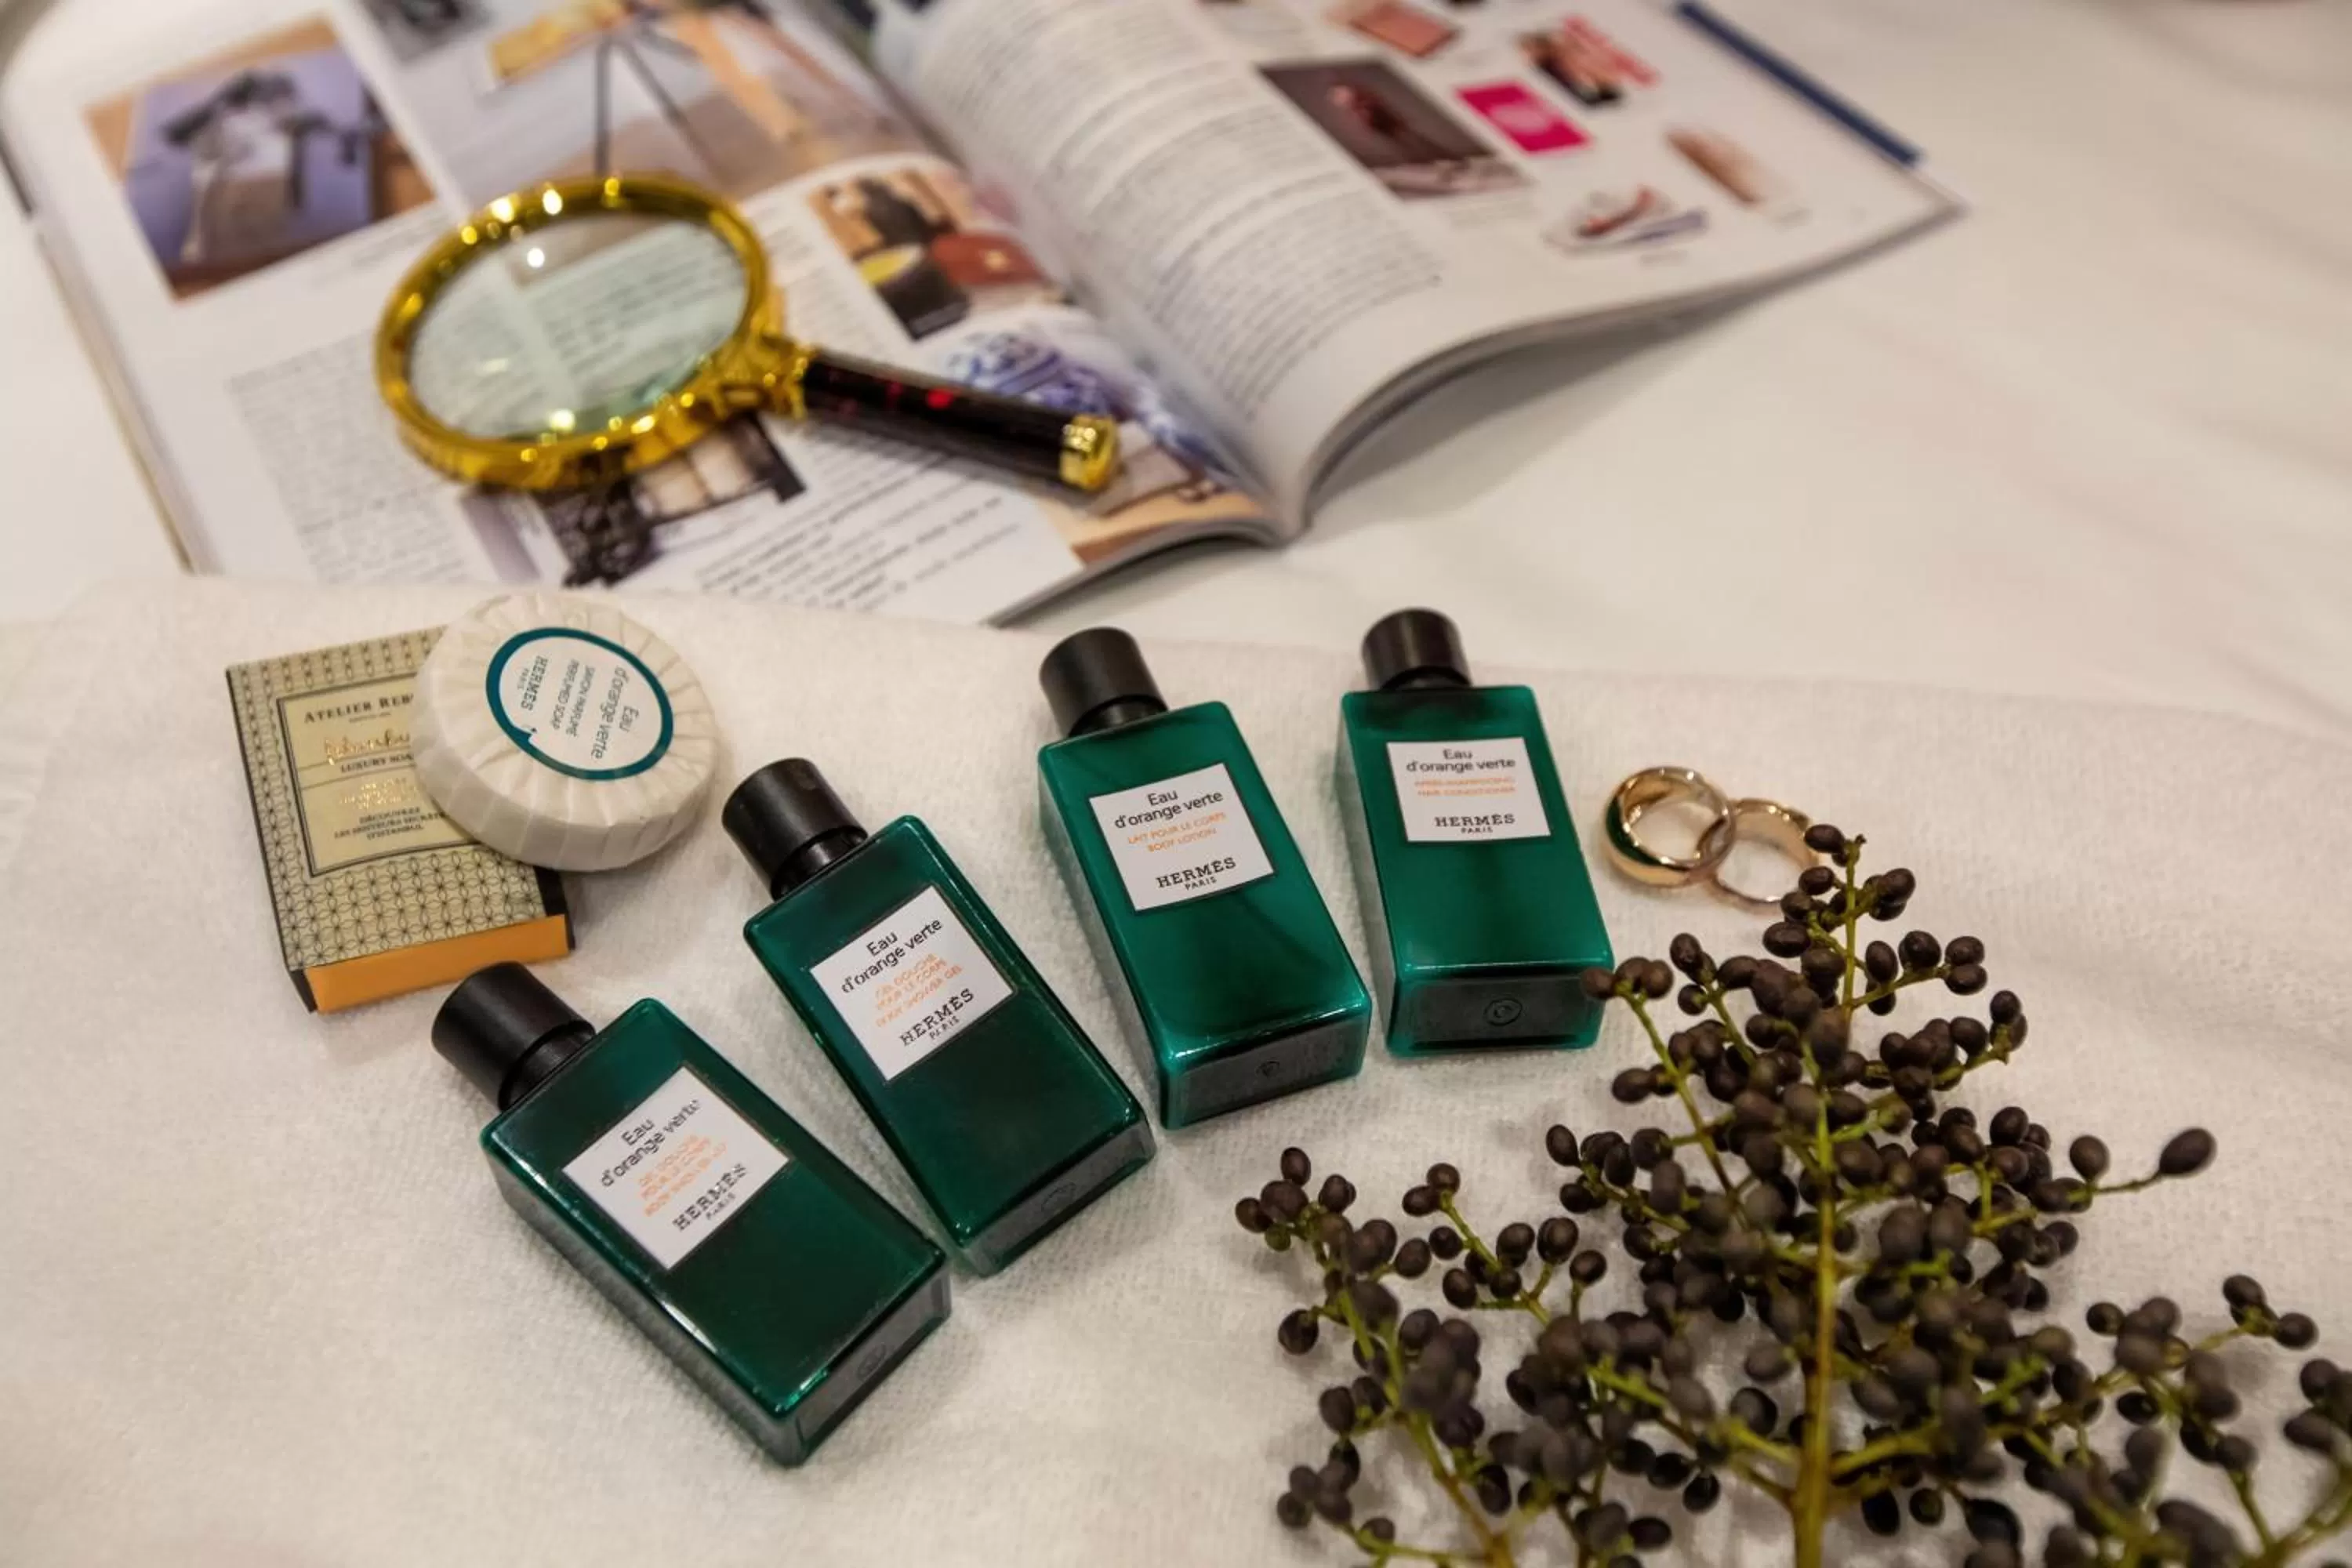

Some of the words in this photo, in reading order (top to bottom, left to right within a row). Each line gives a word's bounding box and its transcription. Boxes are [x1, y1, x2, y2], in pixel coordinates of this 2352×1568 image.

[600, 665, 630, 723] d'orange
[304, 700, 372, 724] ATELIER
[619, 706, 640, 732] Eau
[590, 724, 609, 760] verte
[1443, 748, 1472, 760] Eau
[389, 753, 414, 765] SOA
[1406, 760, 1473, 773] d'orange
[1475, 758, 1515, 769] verte
[1114, 804, 1182, 829] d'orange
[1183, 792, 1224, 811] verte
[1147, 790, 1179, 807] Eau
[1185, 877, 1217, 891] PARIS
[866, 931, 898, 956] Eau
[840, 946, 906, 994] d'orange
[904, 919, 942, 949] verte
[929, 1015, 960, 1040] PARIS
[601, 1130, 666, 1188] d'orange
[664, 1099, 701, 1134] verte
[621, 1118, 655, 1146] Eau
[706, 1192, 736, 1220] PARIS
